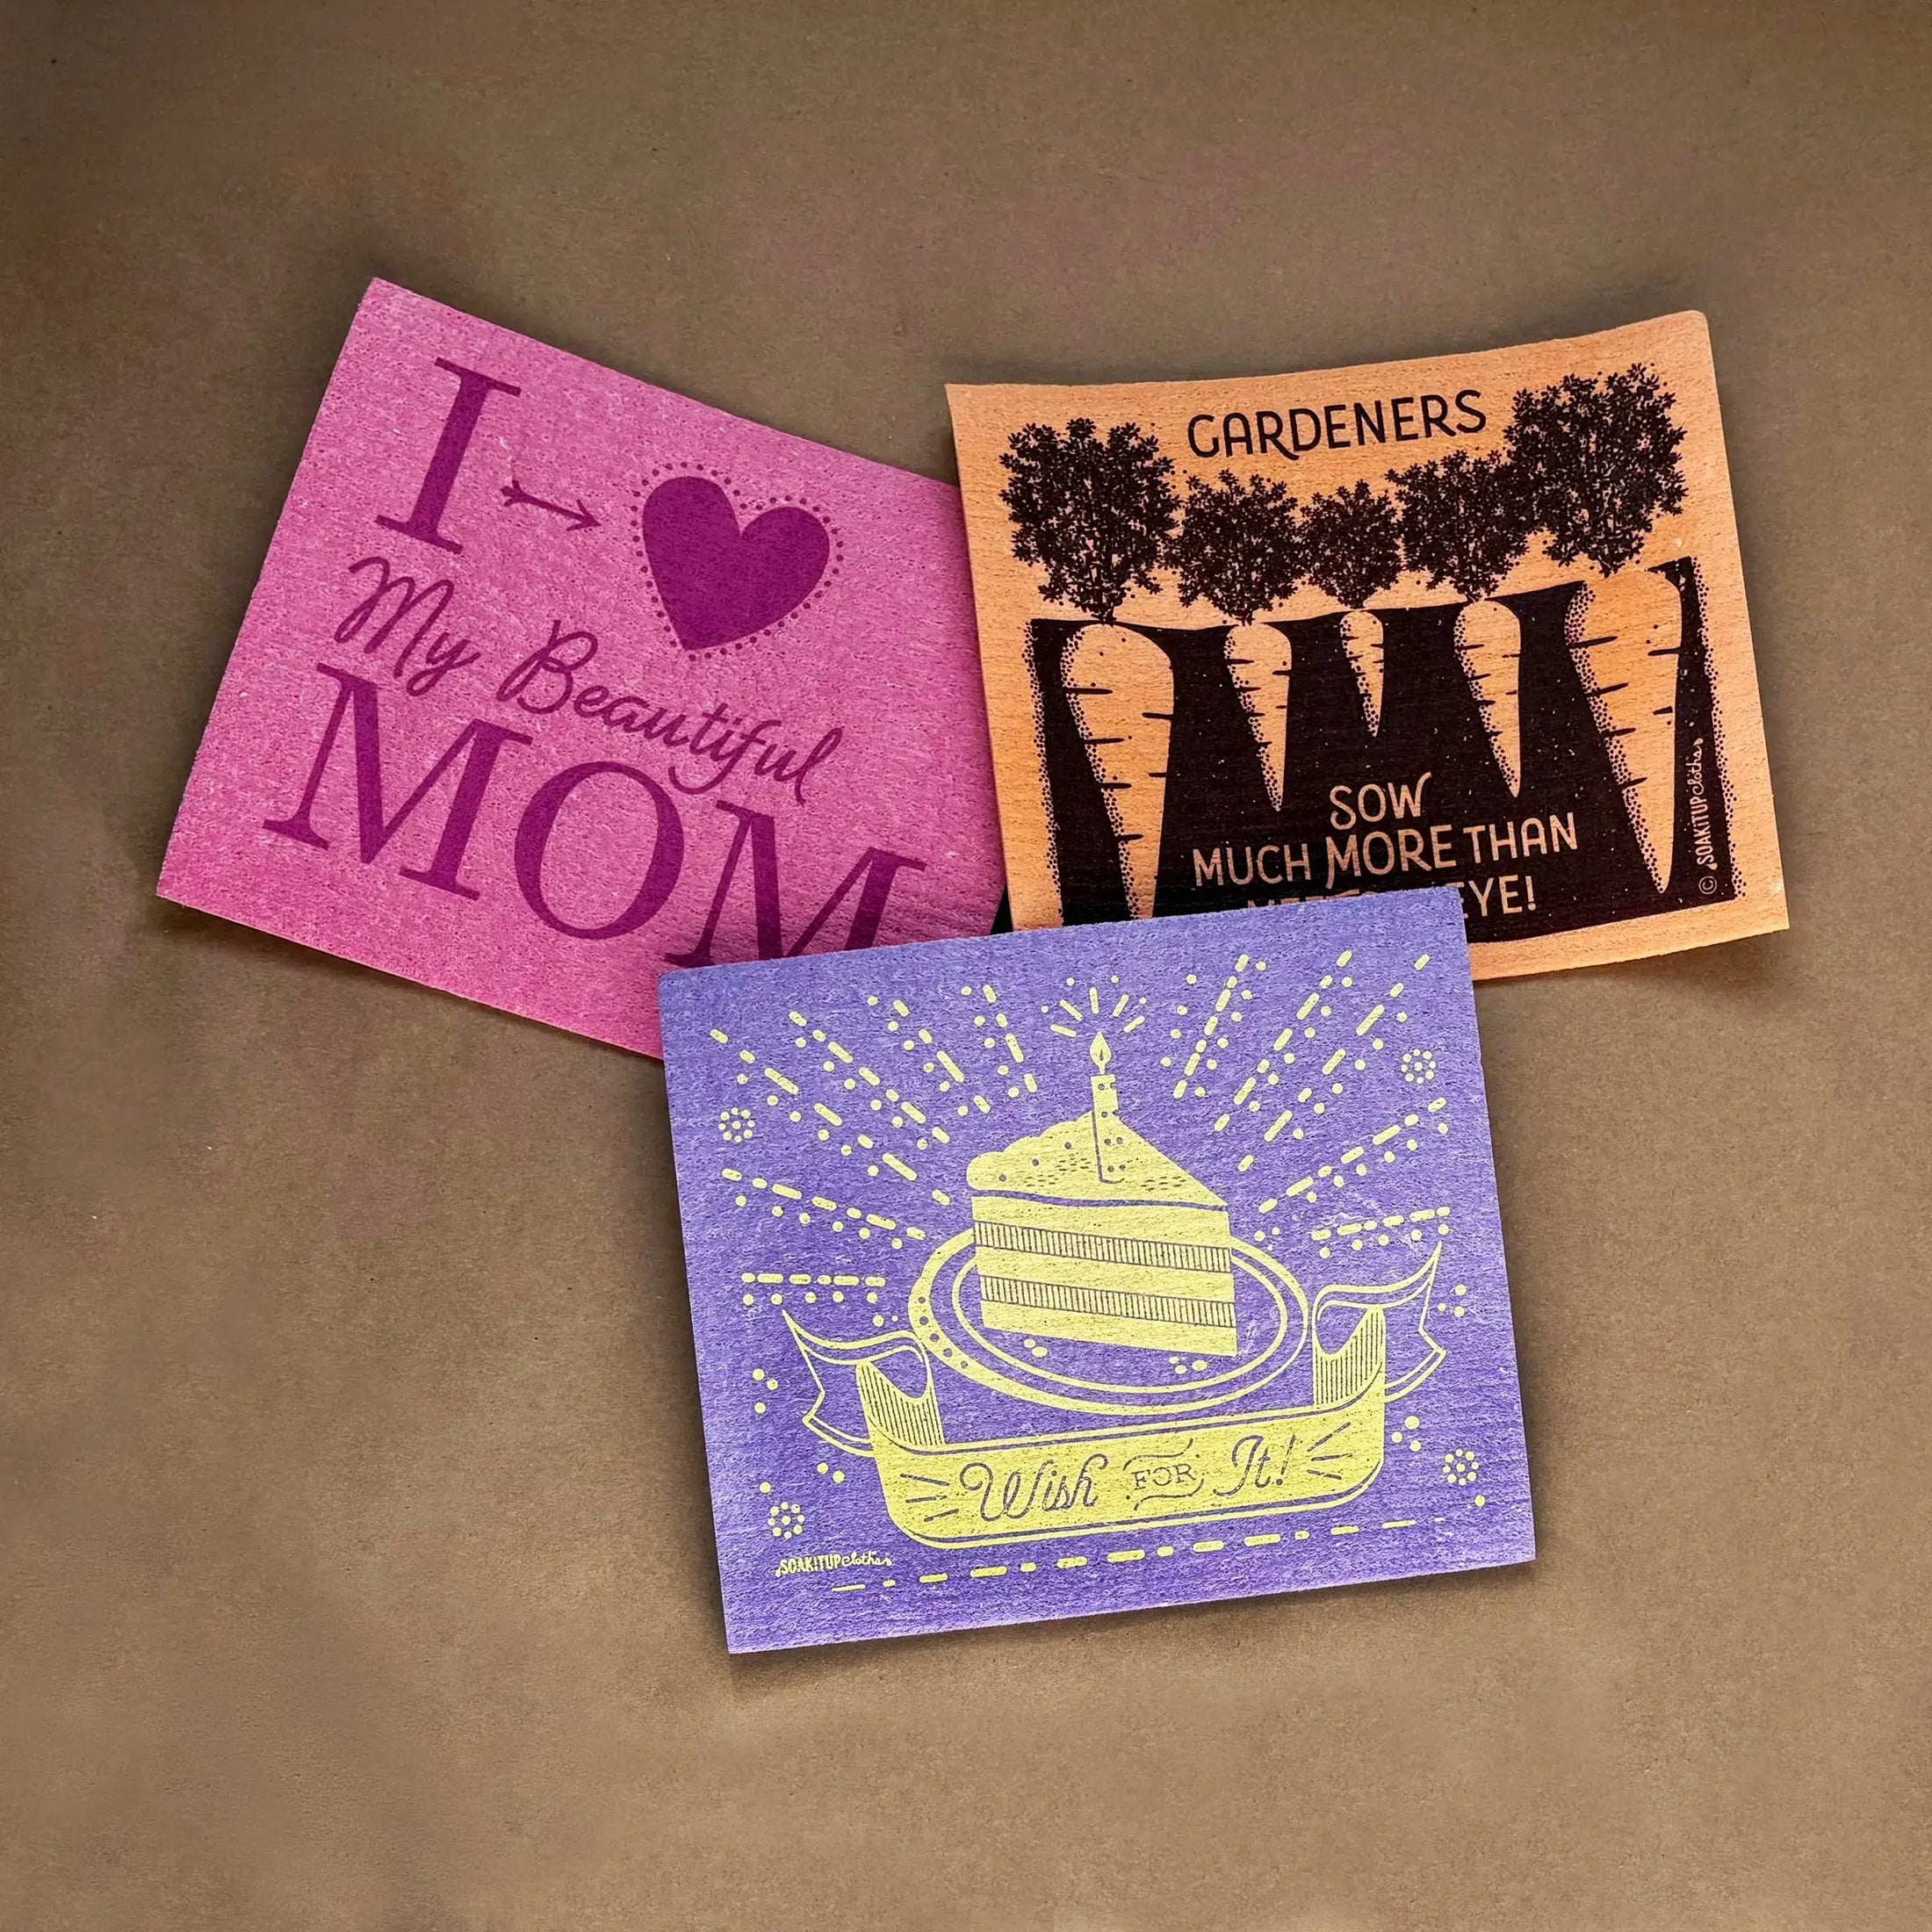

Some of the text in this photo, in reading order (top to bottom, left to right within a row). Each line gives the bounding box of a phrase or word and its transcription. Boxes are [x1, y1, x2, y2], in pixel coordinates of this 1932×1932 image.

[375, 357, 522, 555] I
[1187, 389, 1487, 461] GARDENERS
[334, 556, 843, 805] My Beautiful
[261, 662, 927, 969] MOM
[1330, 771, 1432, 831] SOW
[1192, 811, 1578, 890] MUCH MORE THAN
[959, 1434, 1296, 1523] Wish FOR It!
